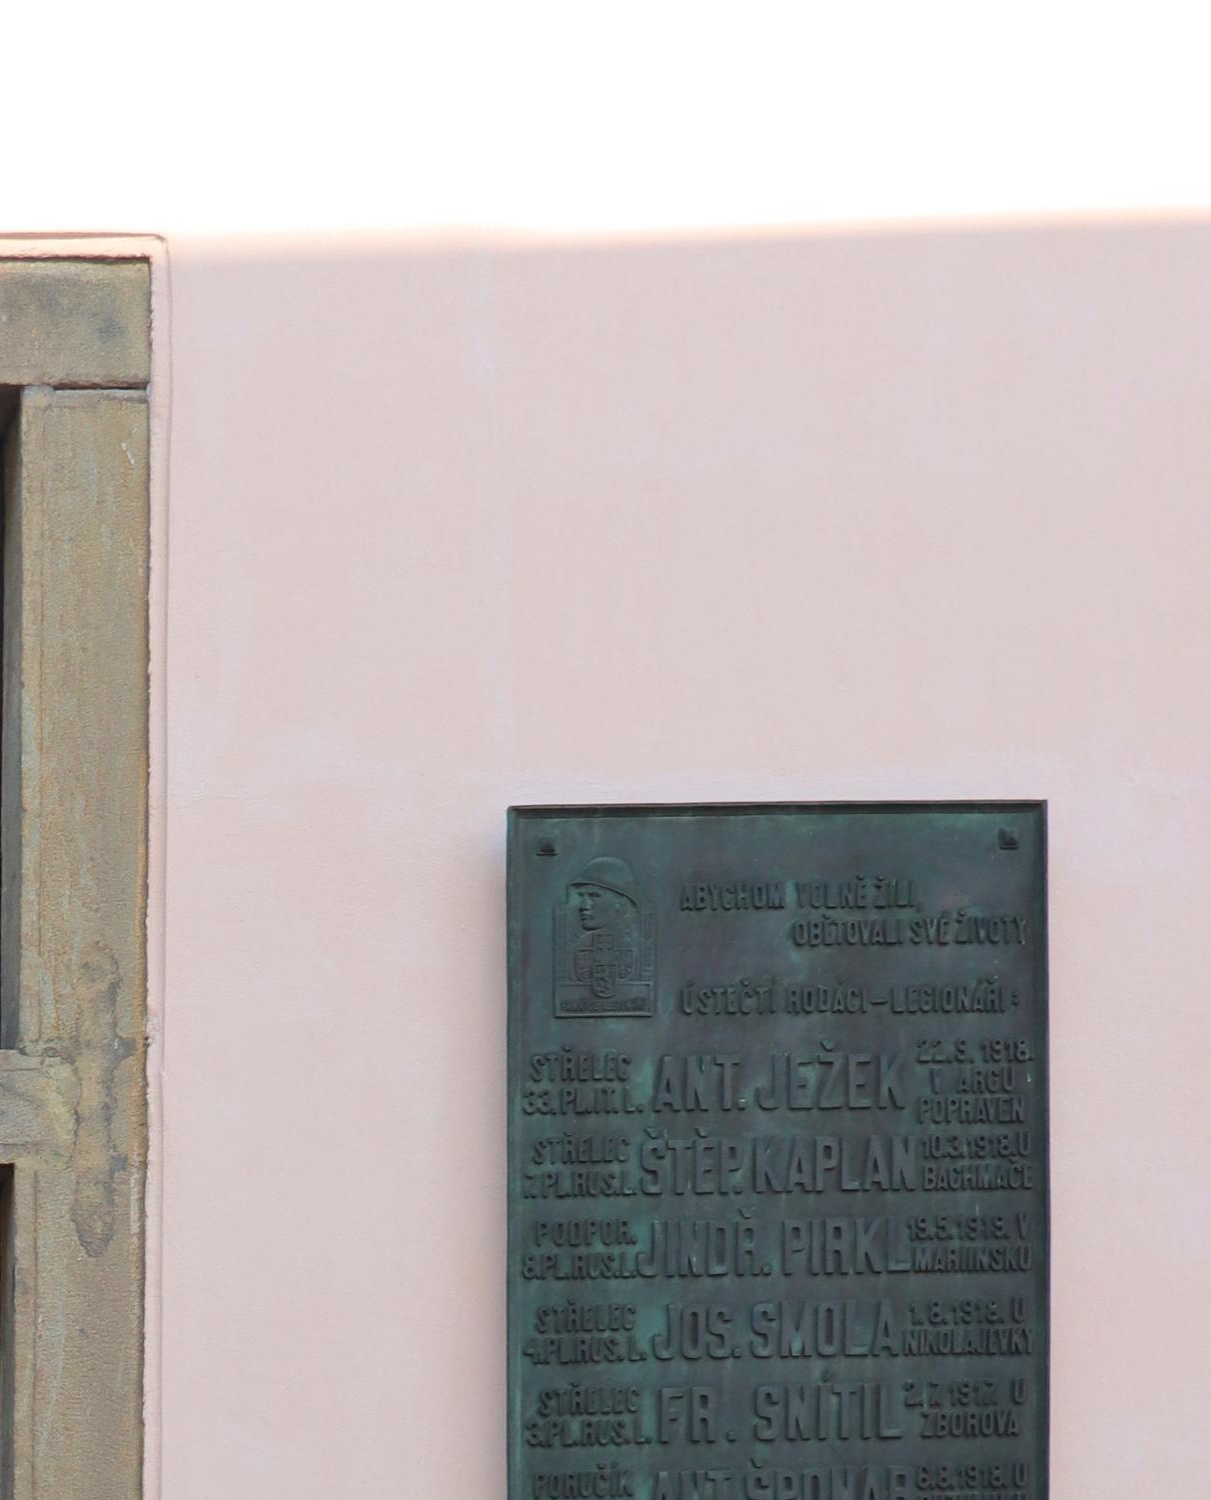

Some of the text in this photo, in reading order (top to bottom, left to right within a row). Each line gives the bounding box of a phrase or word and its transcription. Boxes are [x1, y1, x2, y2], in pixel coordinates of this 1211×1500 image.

[679, 881, 785, 911] ABYCHOM
[791, 909, 1028, 948] OBĚTOVALI SVÉ ŽIVOTY
[679, 977, 777, 1015] ÚSTEČTÍ
[530, 1044, 631, 1083] STŘELEC
[652, 1039, 906, 1113] ANT. JEŽEK
[917, 1096, 1026, 1124] POPRAVEN
[531, 1129, 630, 1165] STŘELEC
[640, 1124, 916, 1197] ŠTĚP. KAPLAN
[923, 1156, 1034, 1192] BACHMAČE
[534, 1218, 638, 1248] PODPOR.
[637, 1207, 911, 1279] JINDŘ. PIRKL
[911, 1245, 1032, 1274] MARIINSKU
[535, 1299, 637, 1334] STŘELEC
[651, 1300, 900, 1361] JOS. SMOLA
[902, 1328, 1035, 1358] NIKOLAJEVKY
[537, 1381, 642, 1419] STŘELEC
[659, 1368, 904, 1445] FR. SNÍTIL
[920, 1408, 1020, 1439] ZBOROVA
[531, 1461, 634, 1500] PORUČÍK
